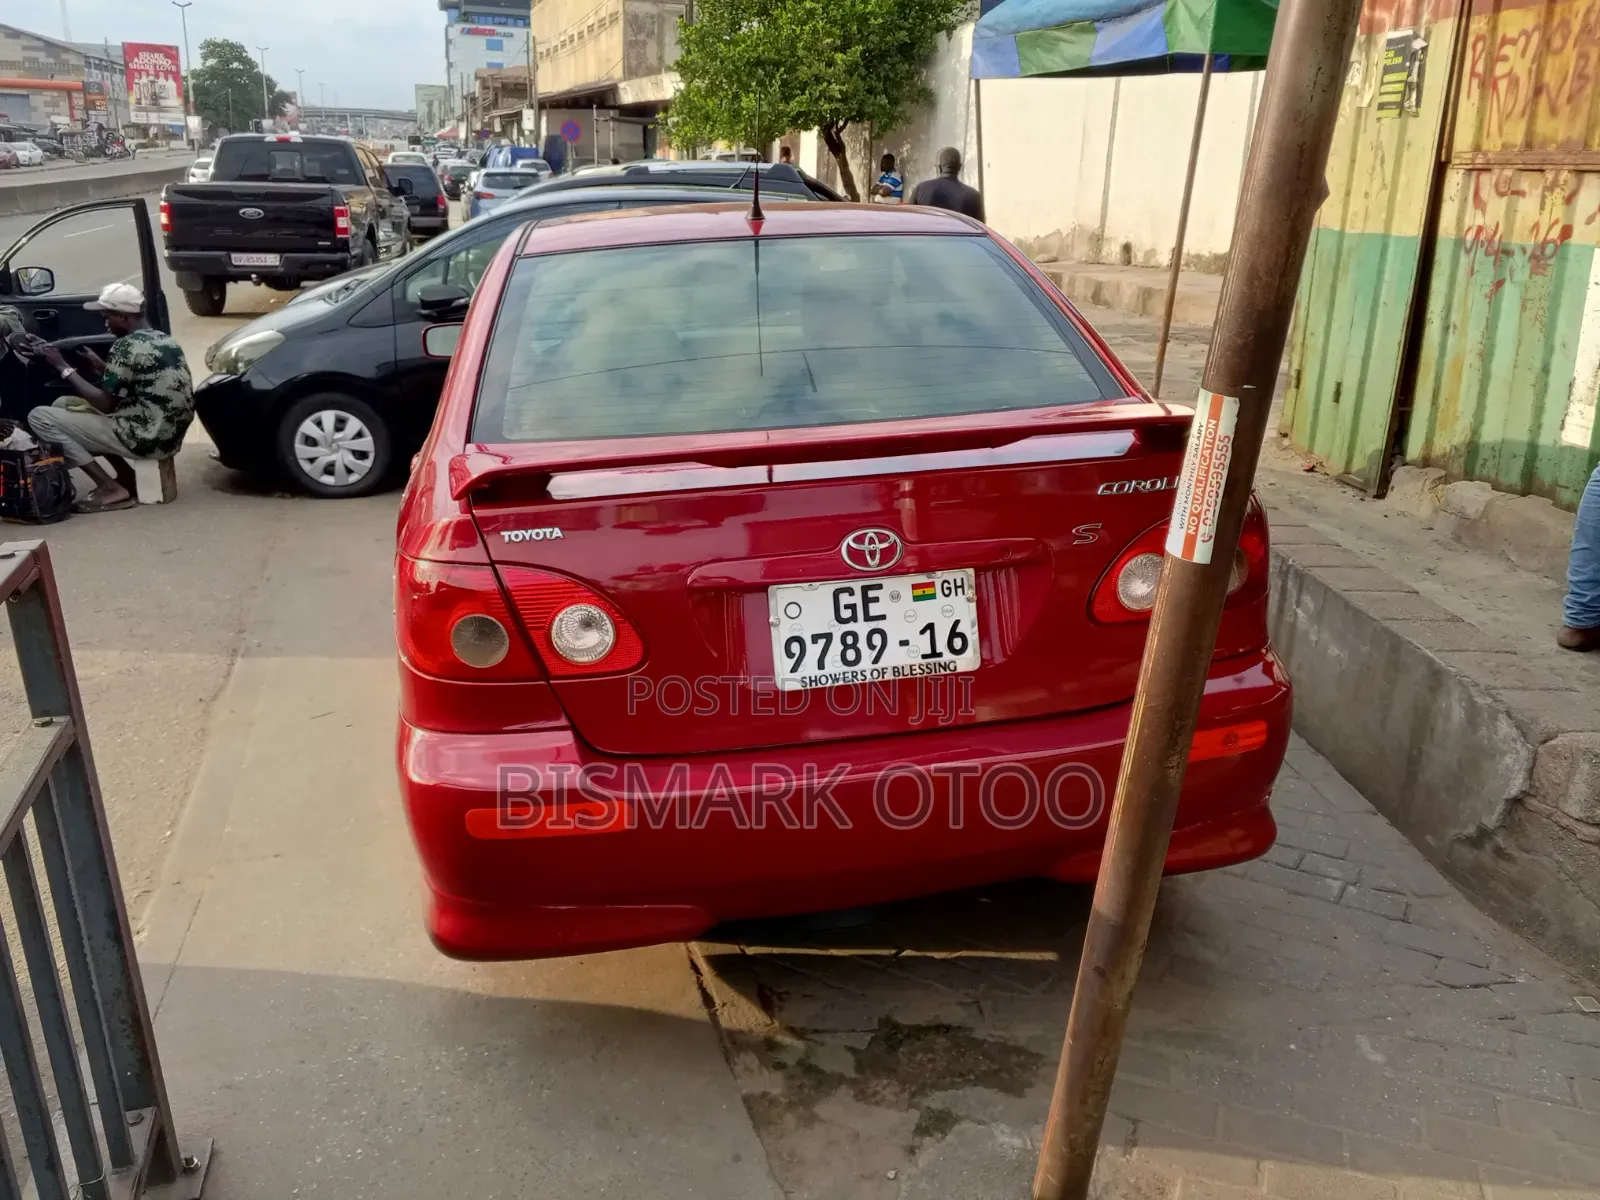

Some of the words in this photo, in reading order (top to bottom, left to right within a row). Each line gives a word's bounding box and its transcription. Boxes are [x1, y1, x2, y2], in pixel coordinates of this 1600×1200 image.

[139, 51, 165, 60] SHARE
[156, 64, 177, 72] LOVE
[1179, 506, 1188, 530] WITH
[1184, 460, 1197, 504] MONTHLY
[1193, 422, 1204, 459] SALARY
[1190, 418, 1217, 514] QUALIFICATION
[501, 527, 564, 544] TOYOTA
[1072, 523, 1103, 545] S
[1187, 515, 1198, 535] NO
[832, 583, 887, 625] GE
[940, 577, 966, 598] GH
[800, 670, 868, 688] SHOWERS
[870, 667, 888, 680] OF
[892, 660, 957, 678] BLESSING
